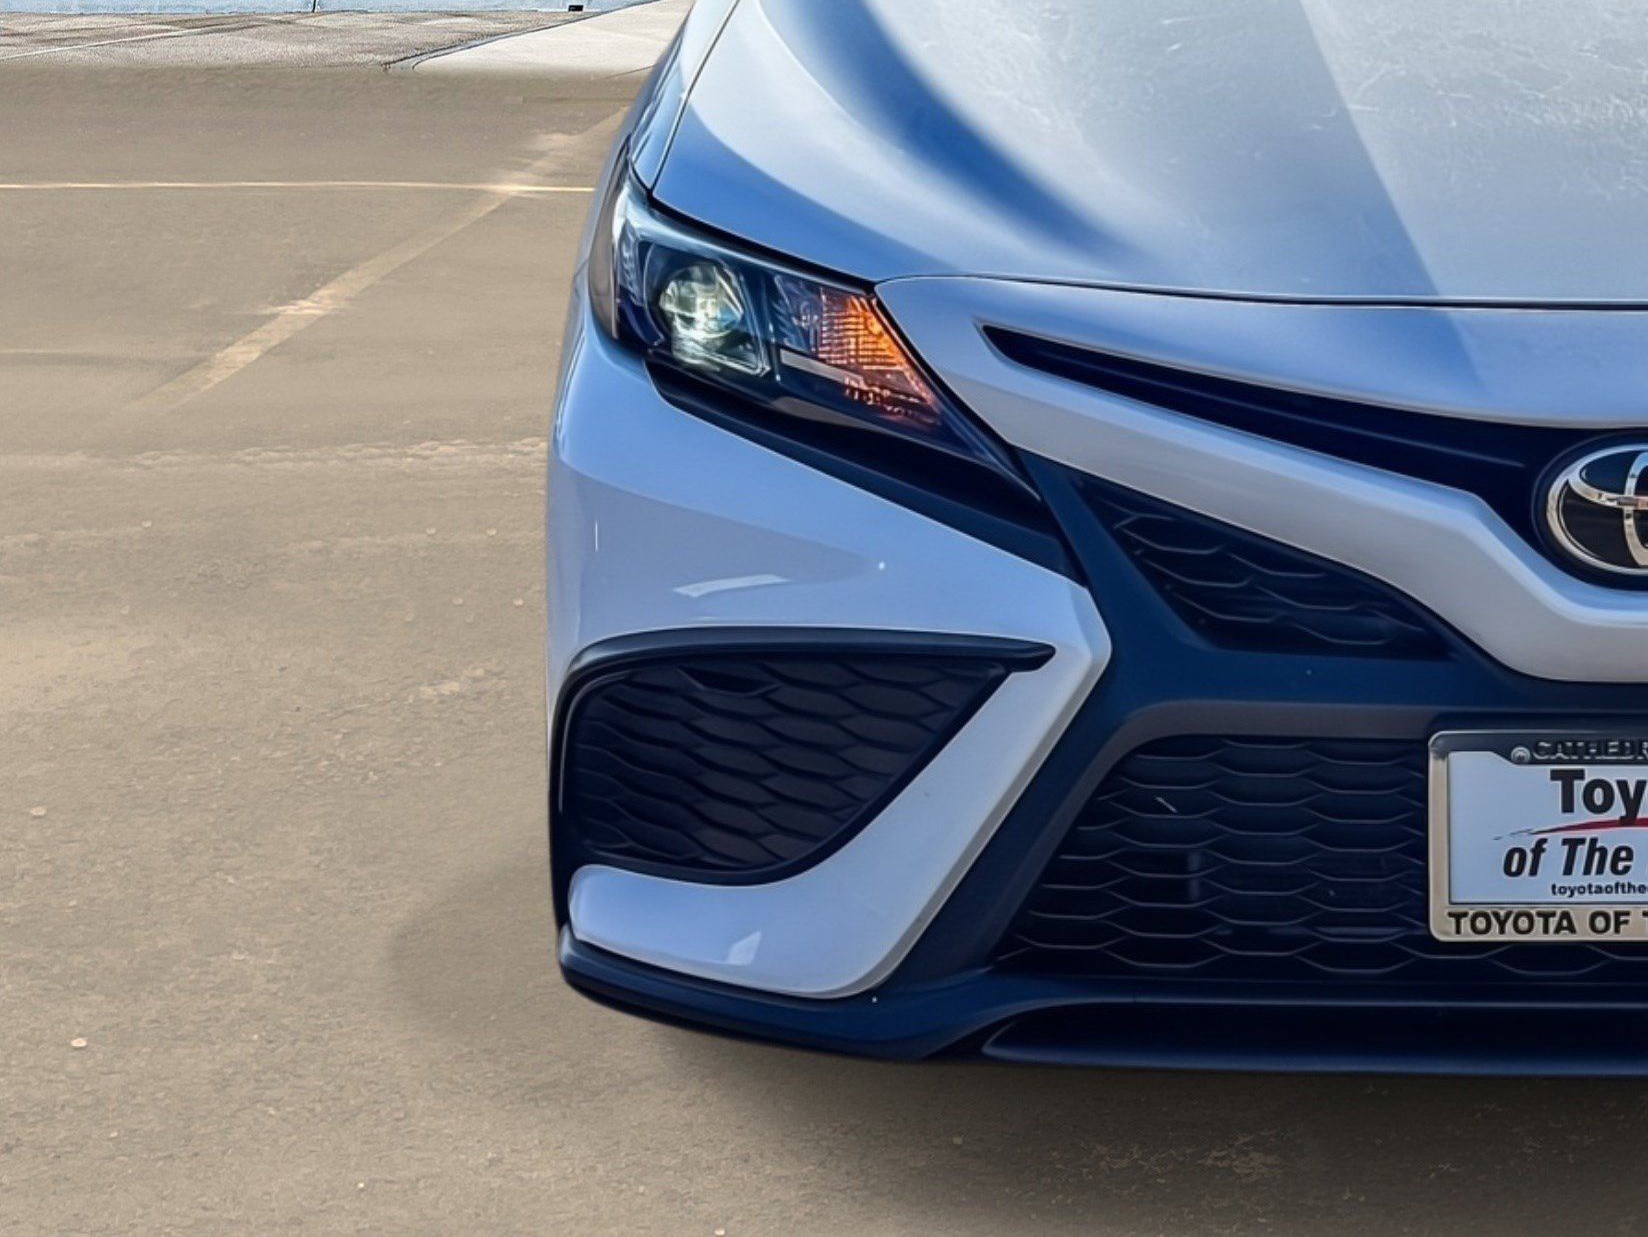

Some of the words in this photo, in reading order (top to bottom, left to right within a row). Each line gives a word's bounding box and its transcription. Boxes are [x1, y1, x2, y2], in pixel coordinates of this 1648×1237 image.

[1503, 837, 1548, 878] of
[1561, 837, 1634, 877] The
[1447, 910, 1577, 936] TOYOTA
[1588, 910, 1631, 935] OF
